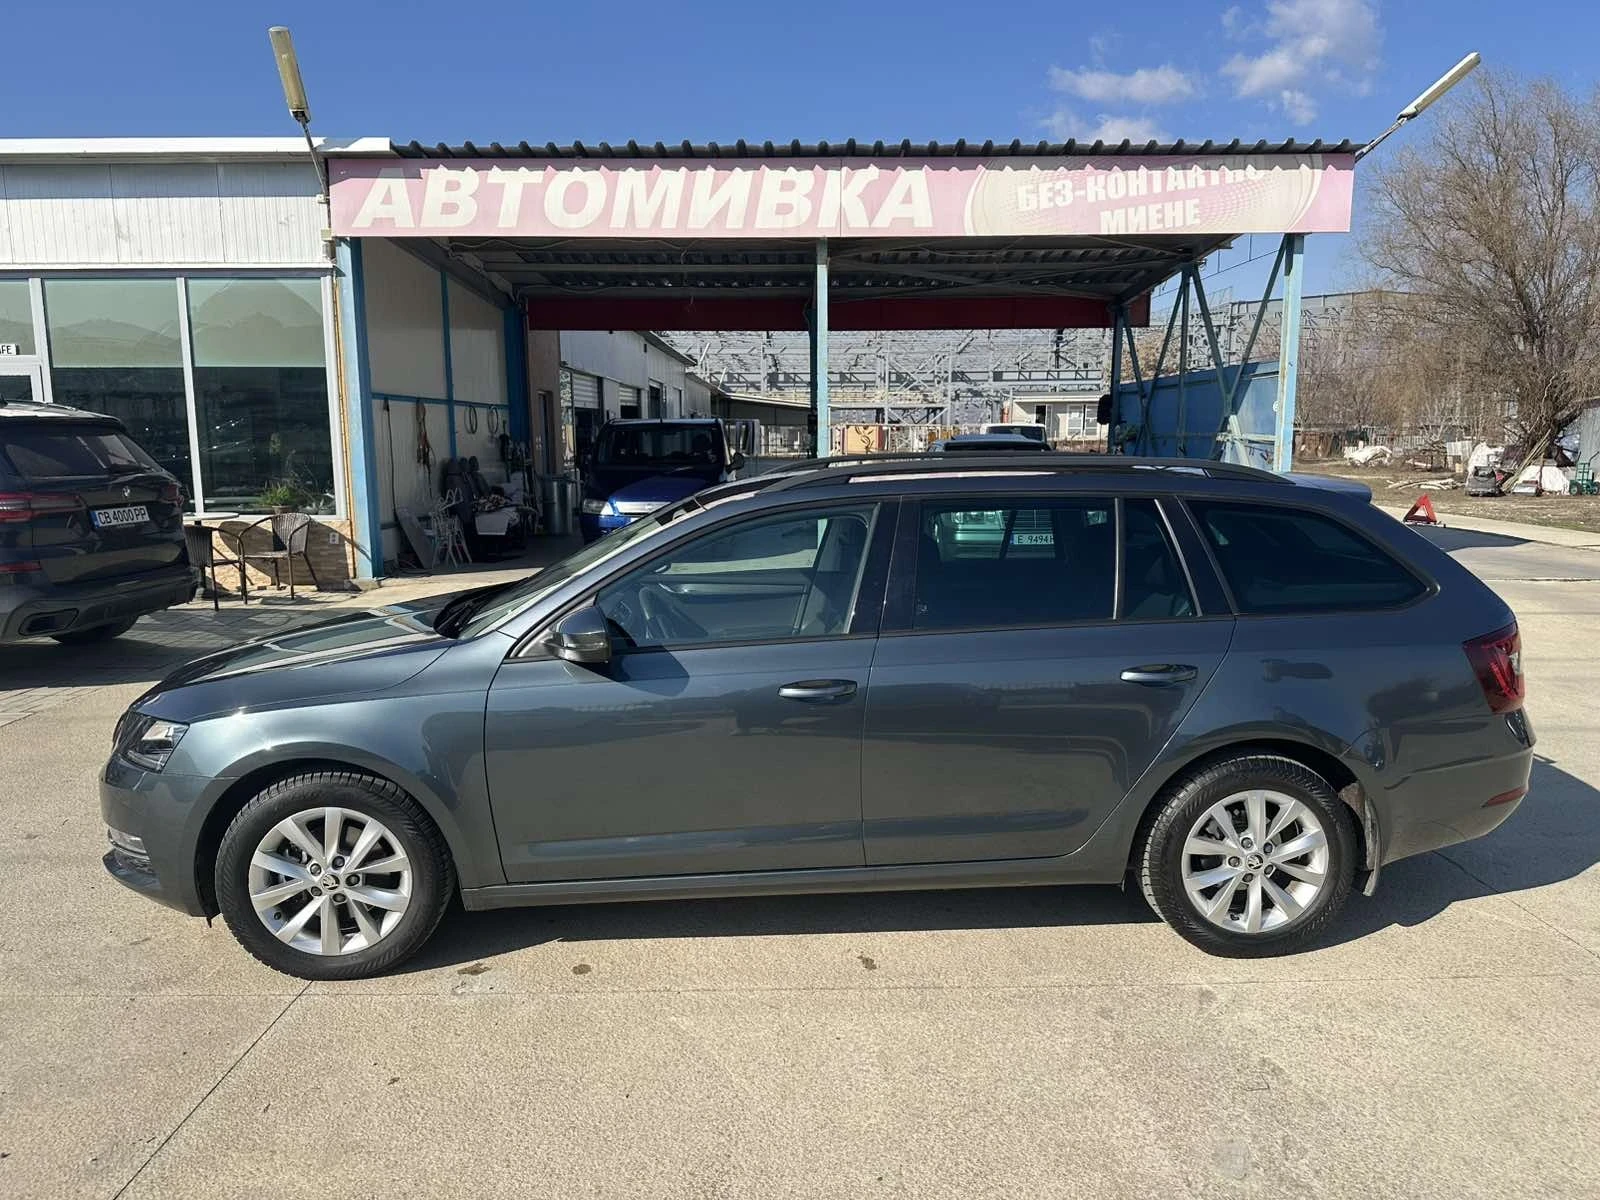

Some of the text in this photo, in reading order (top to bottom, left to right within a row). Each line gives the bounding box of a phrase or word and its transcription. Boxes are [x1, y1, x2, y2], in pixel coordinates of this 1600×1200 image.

[351, 167, 934, 229] АВТОМИВКА
[1100, 198, 1201, 233] МИЕНЕ
[0, 345, 12, 355] FE
[98, 507, 146, 525] CB 4000 PP
